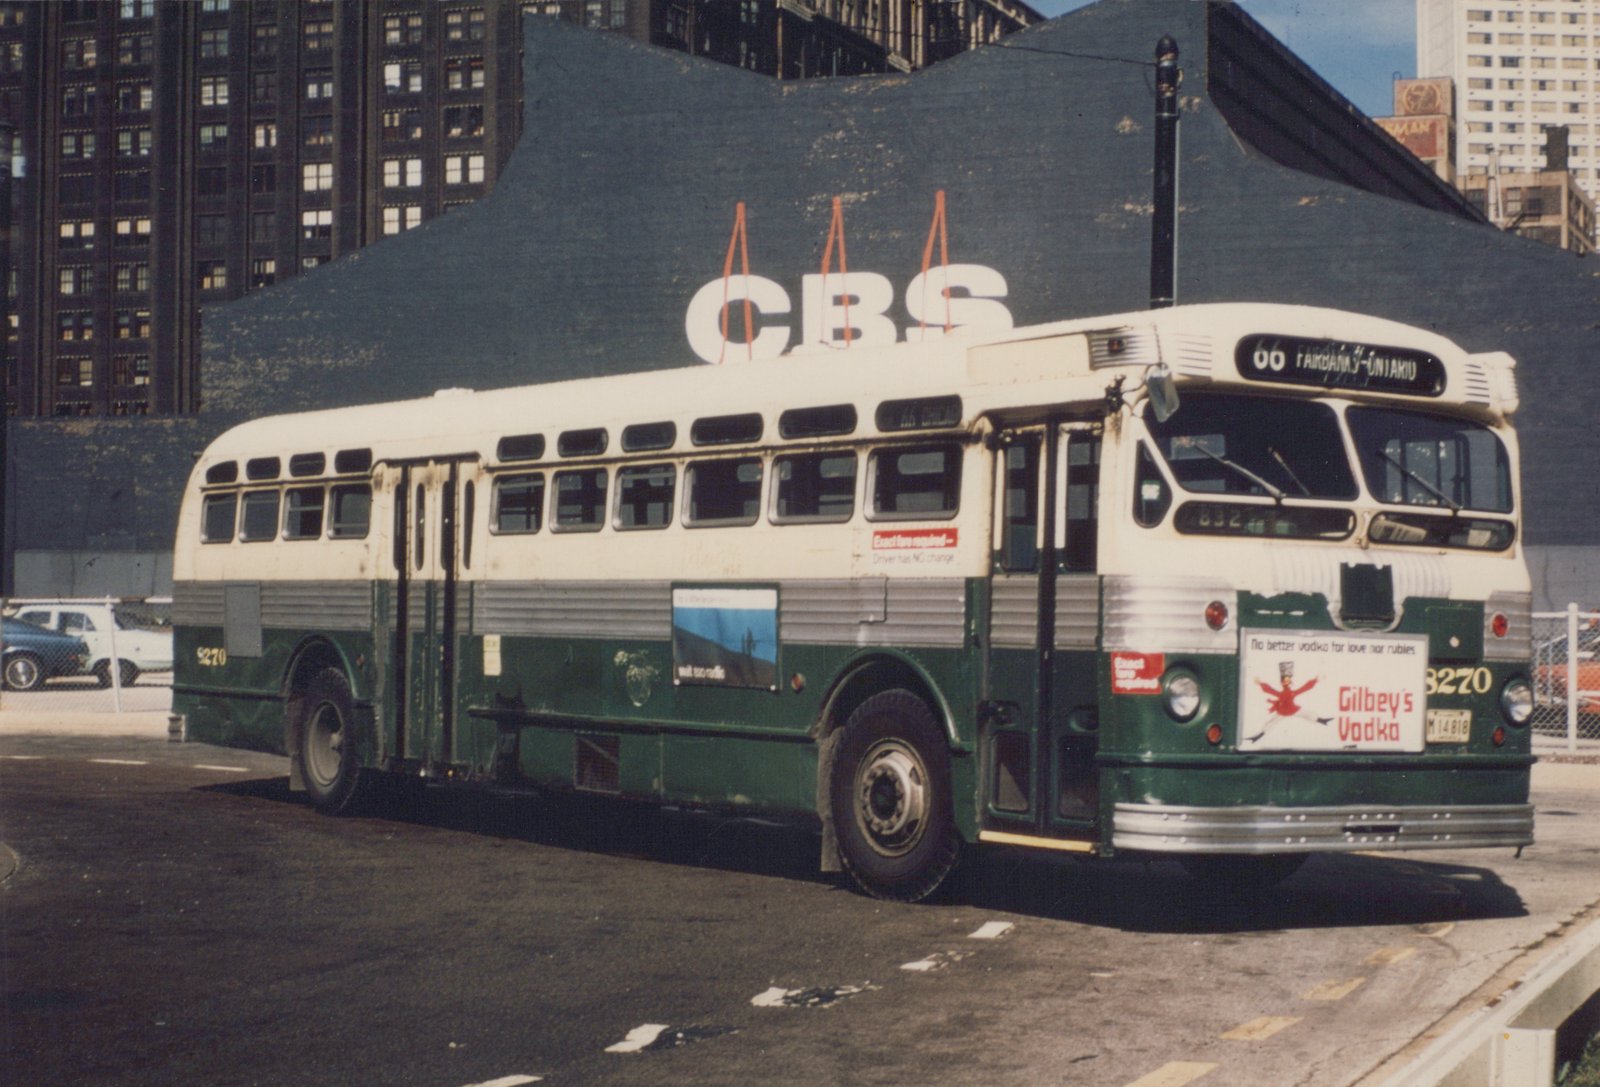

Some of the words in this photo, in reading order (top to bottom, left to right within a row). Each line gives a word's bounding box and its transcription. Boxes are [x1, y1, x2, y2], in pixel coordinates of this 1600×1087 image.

[685, 263, 1014, 365] CBS
[1253, 338, 1286, 372] 66
[1251, 638, 1264, 650] No
[1266, 639, 1295, 651] better
[1299, 641, 1329, 652] vodka
[1331, 641, 1345, 652] for
[1347, 642, 1366, 653] love
[1338, 686, 1414, 719] Gilbey's
[1338, 716, 1399, 742] Vodka
